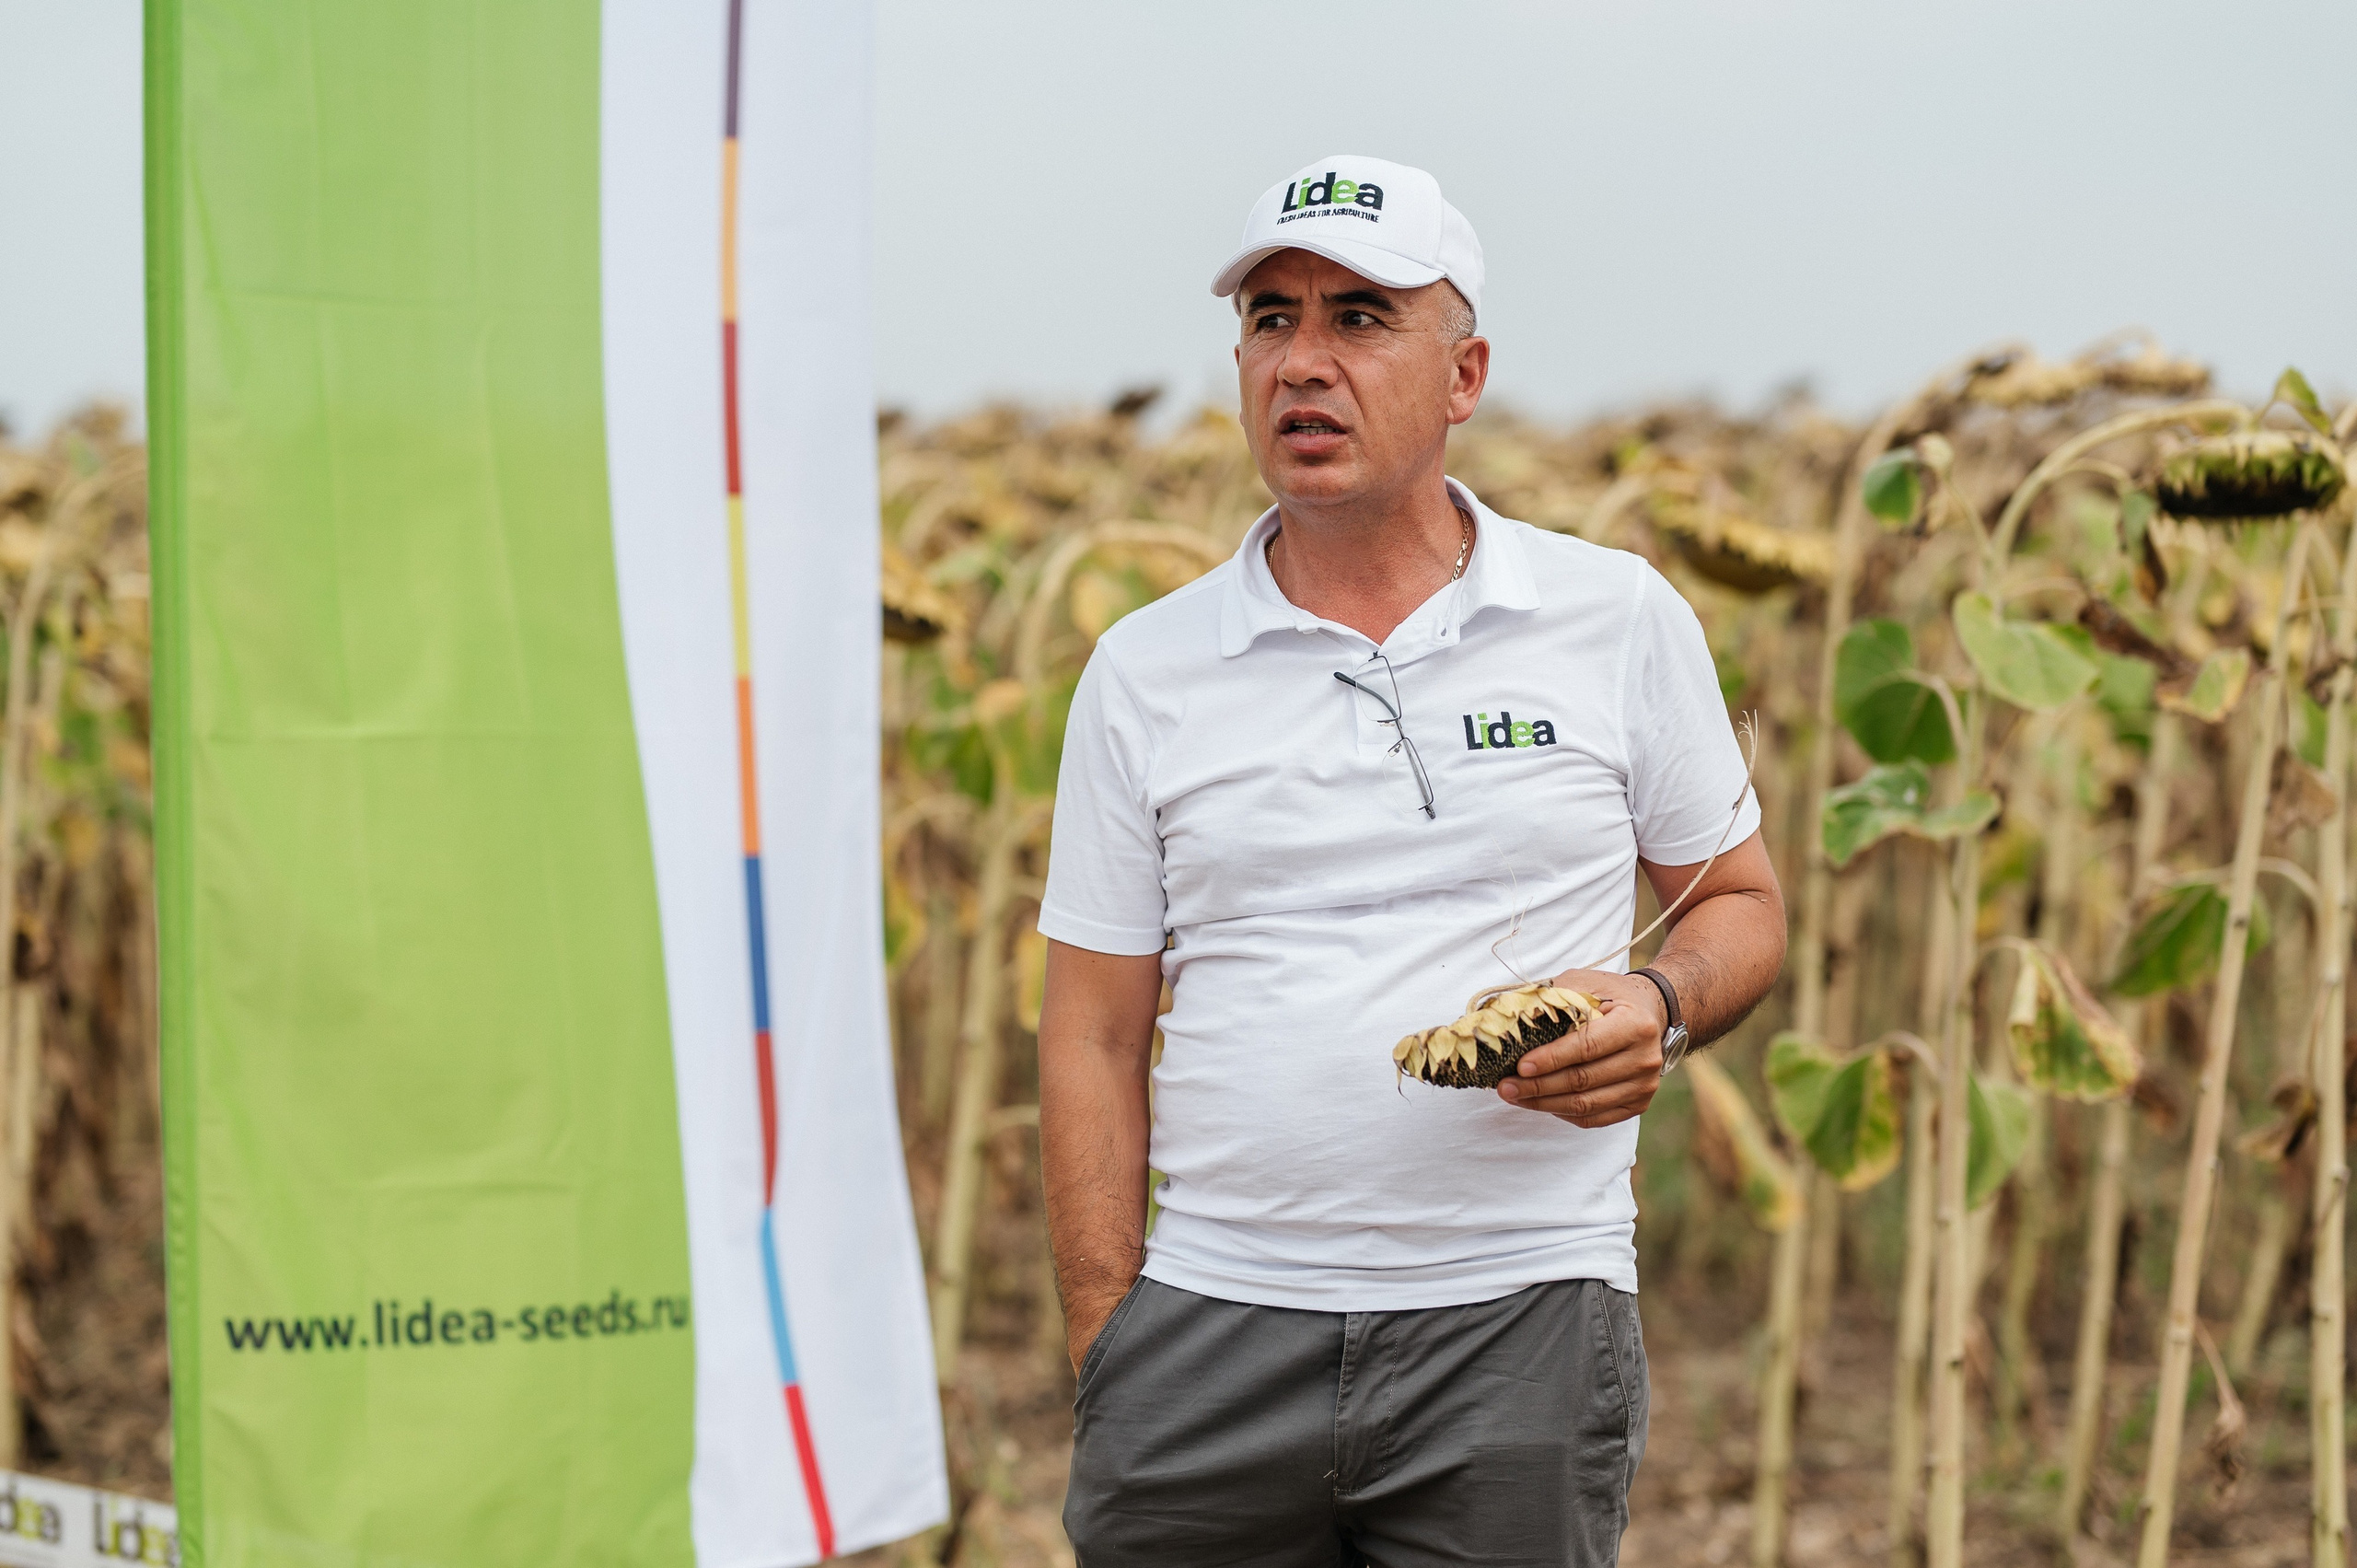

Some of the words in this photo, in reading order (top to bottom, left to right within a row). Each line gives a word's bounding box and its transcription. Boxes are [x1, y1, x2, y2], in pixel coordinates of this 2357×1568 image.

[1282, 171, 1384, 214] Lidea
[1295, 211, 1316, 220] IDEAS
[1330, 207, 1379, 223] AGRICULTURE
[1463, 711, 1557, 750] Lidea
[225, 1288, 689, 1352] www.lidea-seeds.ru
